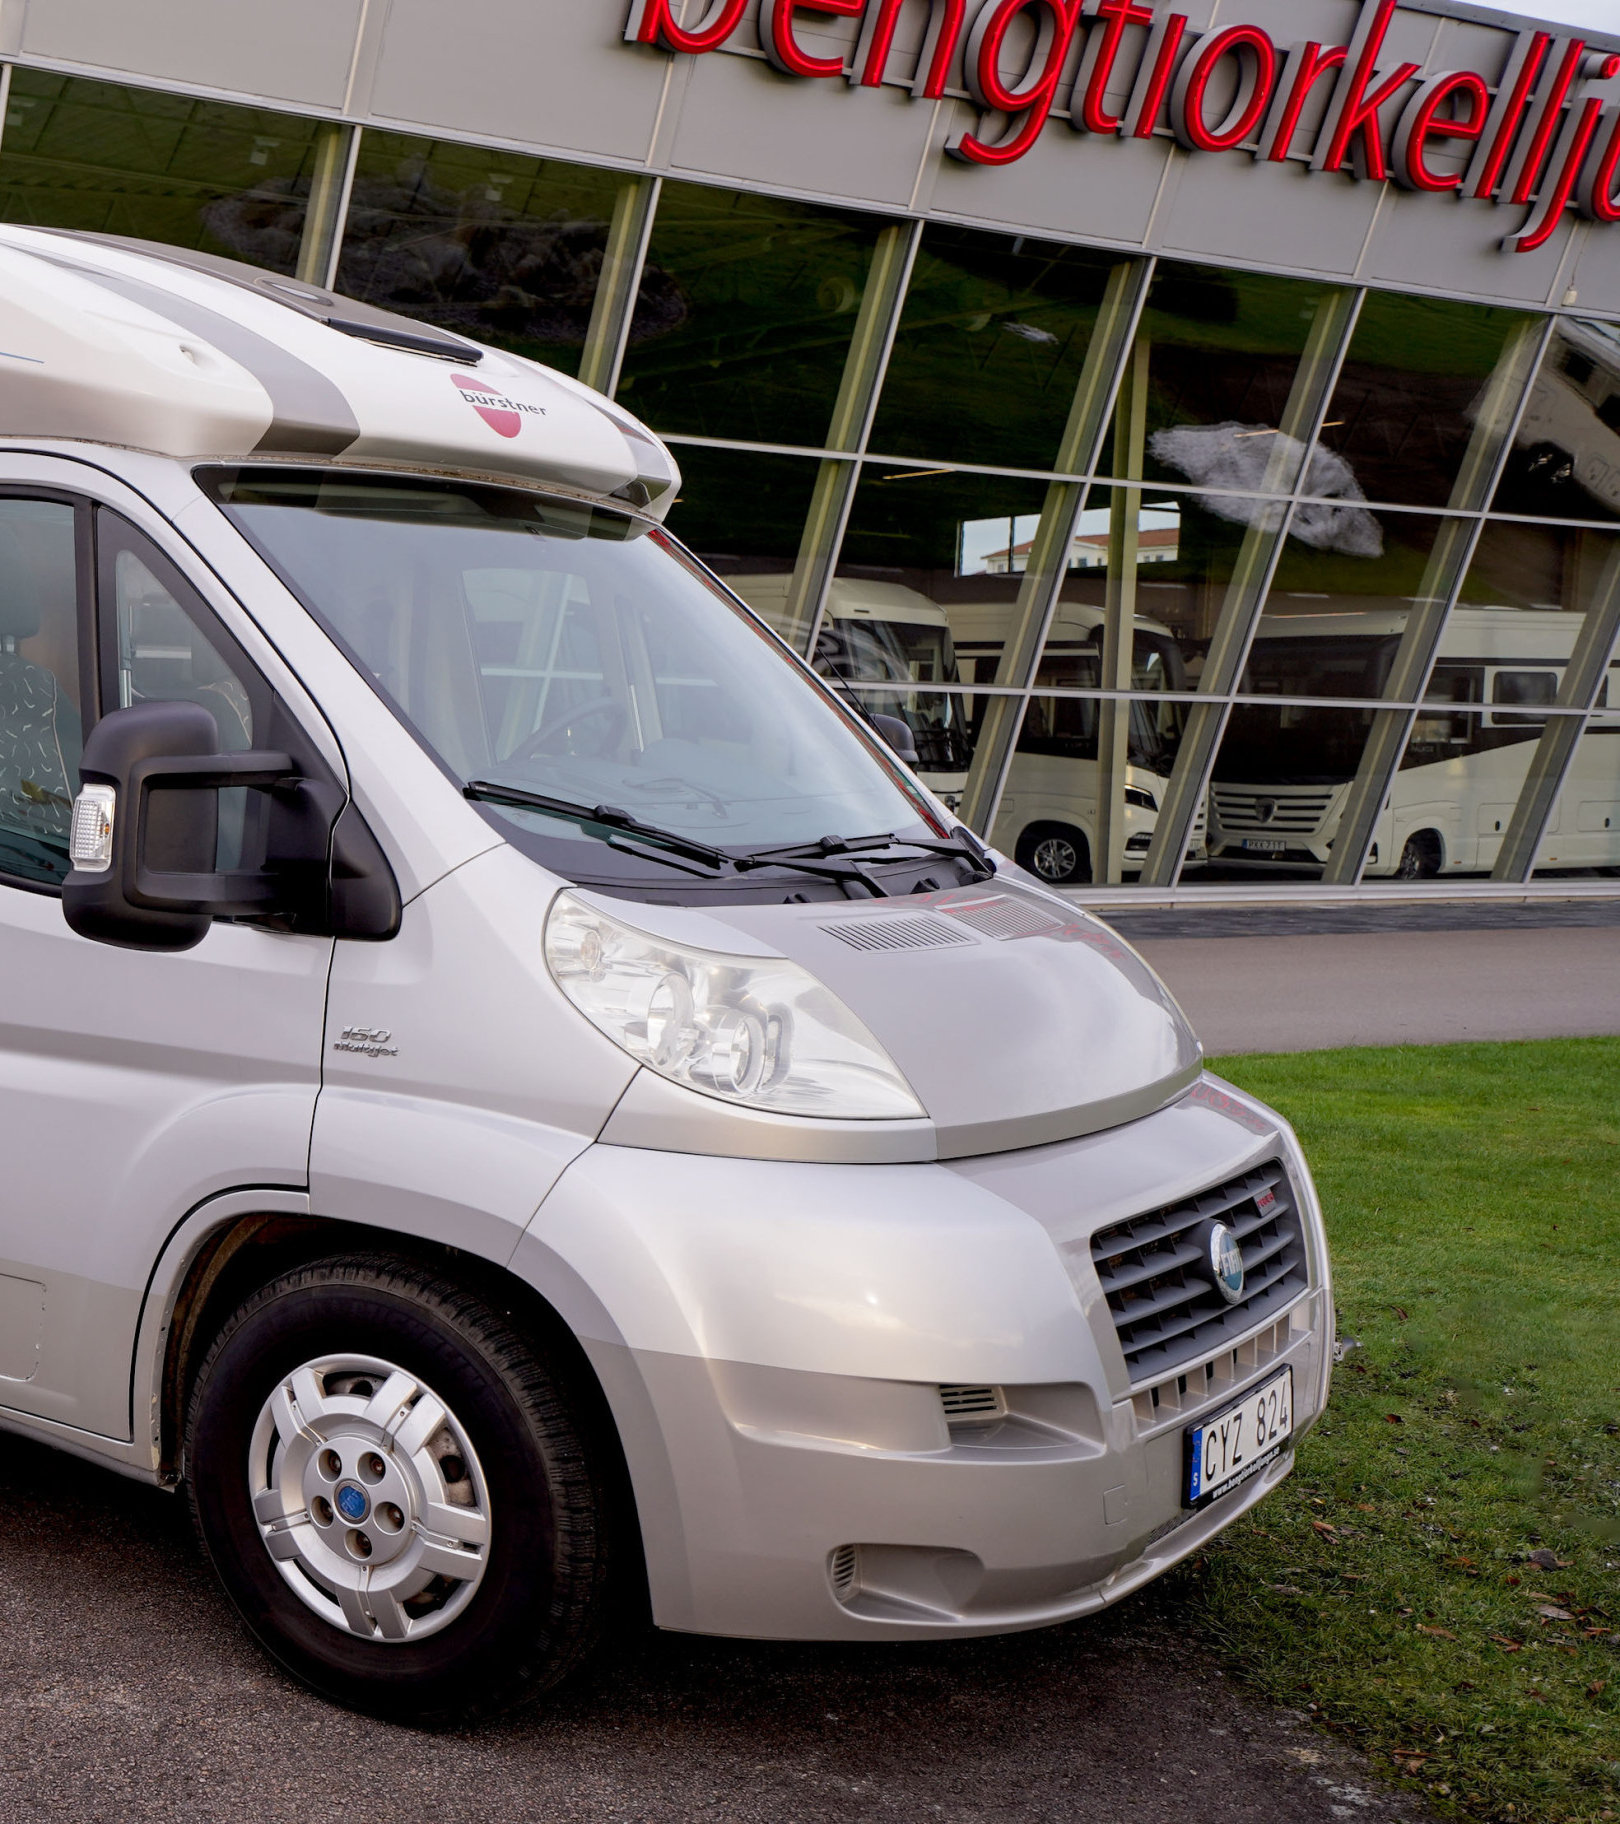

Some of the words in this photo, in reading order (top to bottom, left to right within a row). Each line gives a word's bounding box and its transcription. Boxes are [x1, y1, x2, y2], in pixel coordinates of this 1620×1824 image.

[459, 389, 547, 416] bürstner
[340, 1025, 392, 1043] 160
[1205, 1409, 1243, 1481] CYZ
[1256, 1380, 1288, 1447] 824
[1192, 1472, 1199, 1487] S
